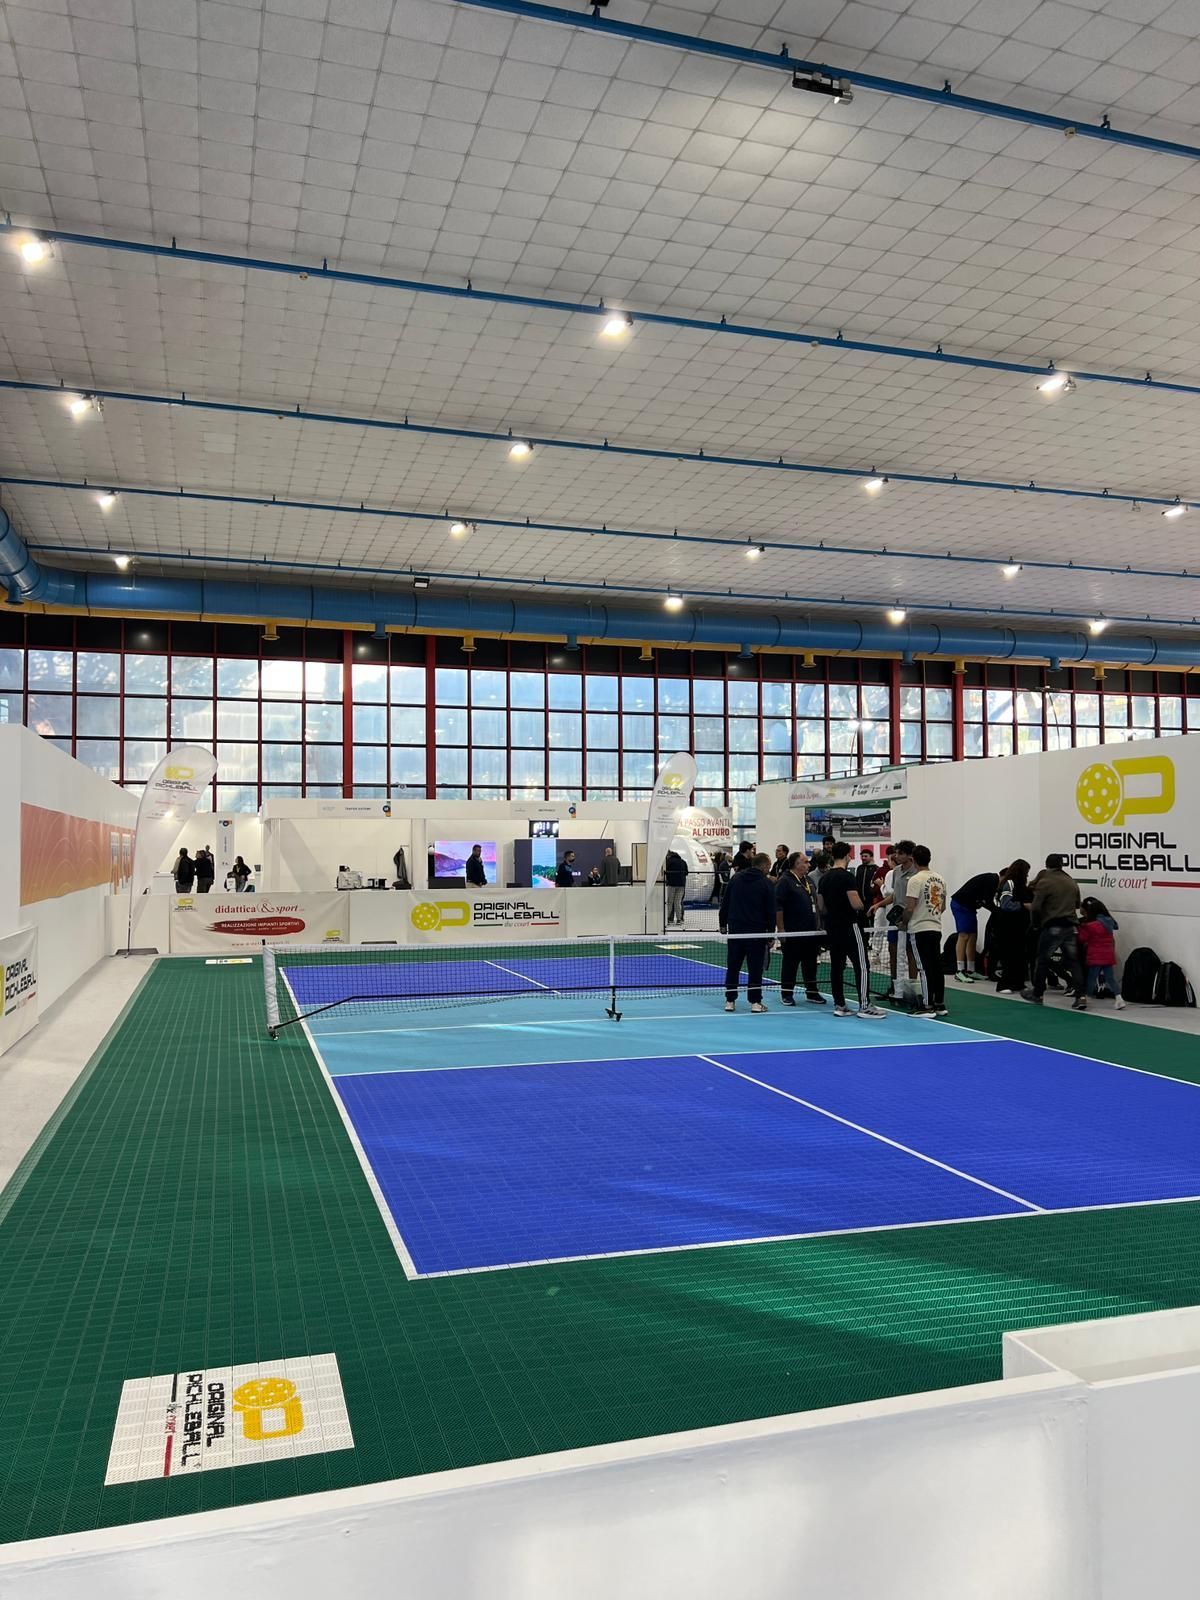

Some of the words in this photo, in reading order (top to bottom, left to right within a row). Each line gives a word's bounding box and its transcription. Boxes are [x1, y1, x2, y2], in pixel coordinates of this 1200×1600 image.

[692, 828, 702, 837] AL
[702, 827, 730, 837] FUTURO
[1075, 832, 1177, 849] ORIGINAL
[1100, 873, 1116, 888] the
[1118, 877, 1147, 889] court
[215, 903, 256, 914] didattica
[276, 905, 298, 915] sport
[473, 902, 535, 911] ORIGINAL
[473, 911, 560, 920] PICKLEBALL
[181, 1374, 202, 1466] PICKLEBALL
[206, 1383, 225, 1447] ORIGINAL
